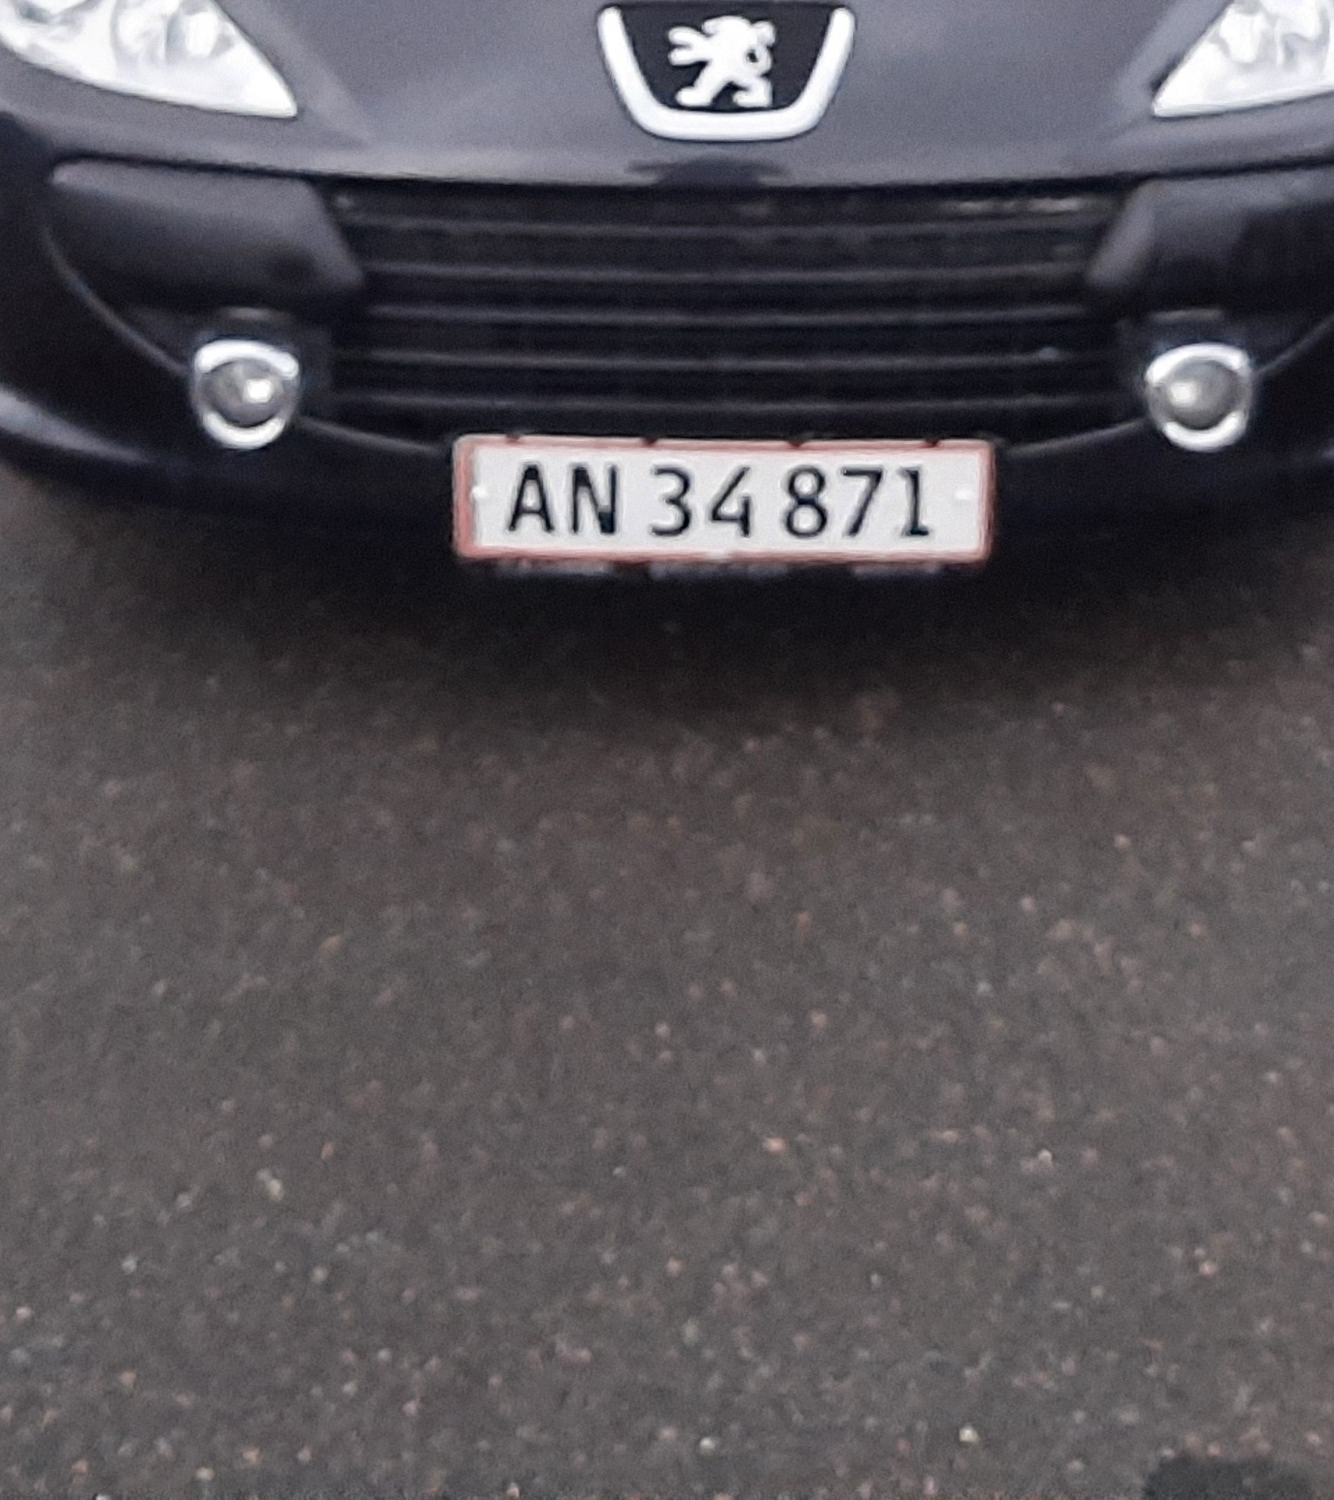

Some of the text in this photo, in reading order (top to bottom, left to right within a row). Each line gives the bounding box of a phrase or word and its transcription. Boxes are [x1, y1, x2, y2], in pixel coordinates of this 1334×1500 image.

[508, 462, 933, 538] AN 34 871
